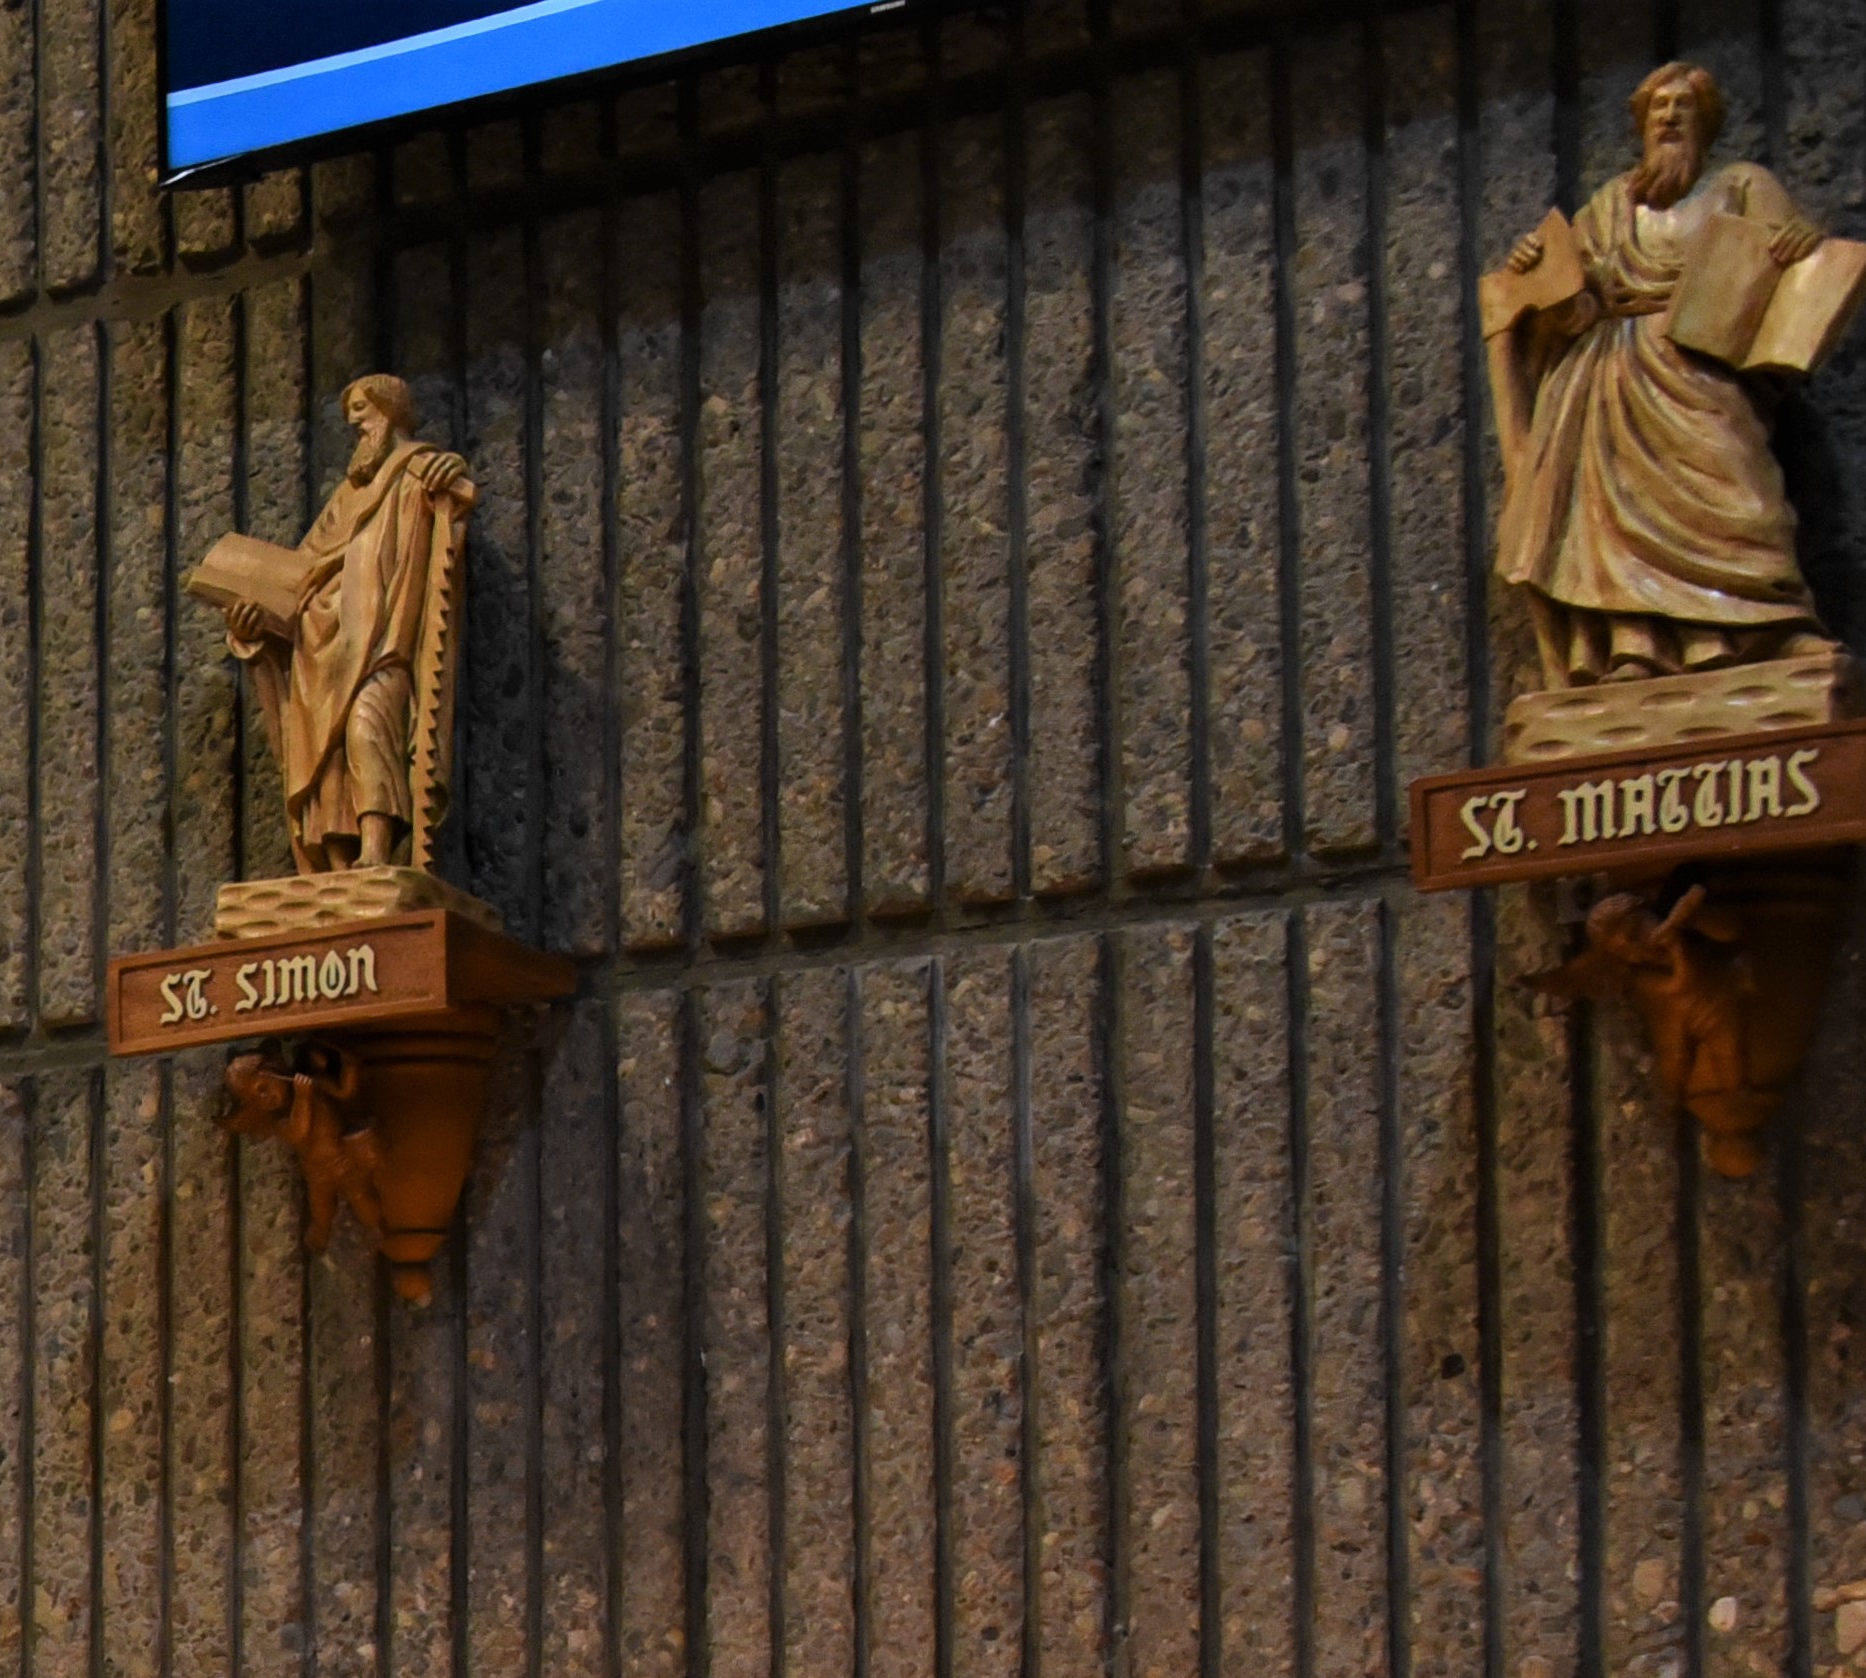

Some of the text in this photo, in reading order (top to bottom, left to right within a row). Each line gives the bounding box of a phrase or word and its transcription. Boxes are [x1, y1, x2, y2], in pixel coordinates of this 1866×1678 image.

[1459, 748, 1821, 861] ST. MATTIAS
[159, 943, 379, 1025] ST. SIMON
